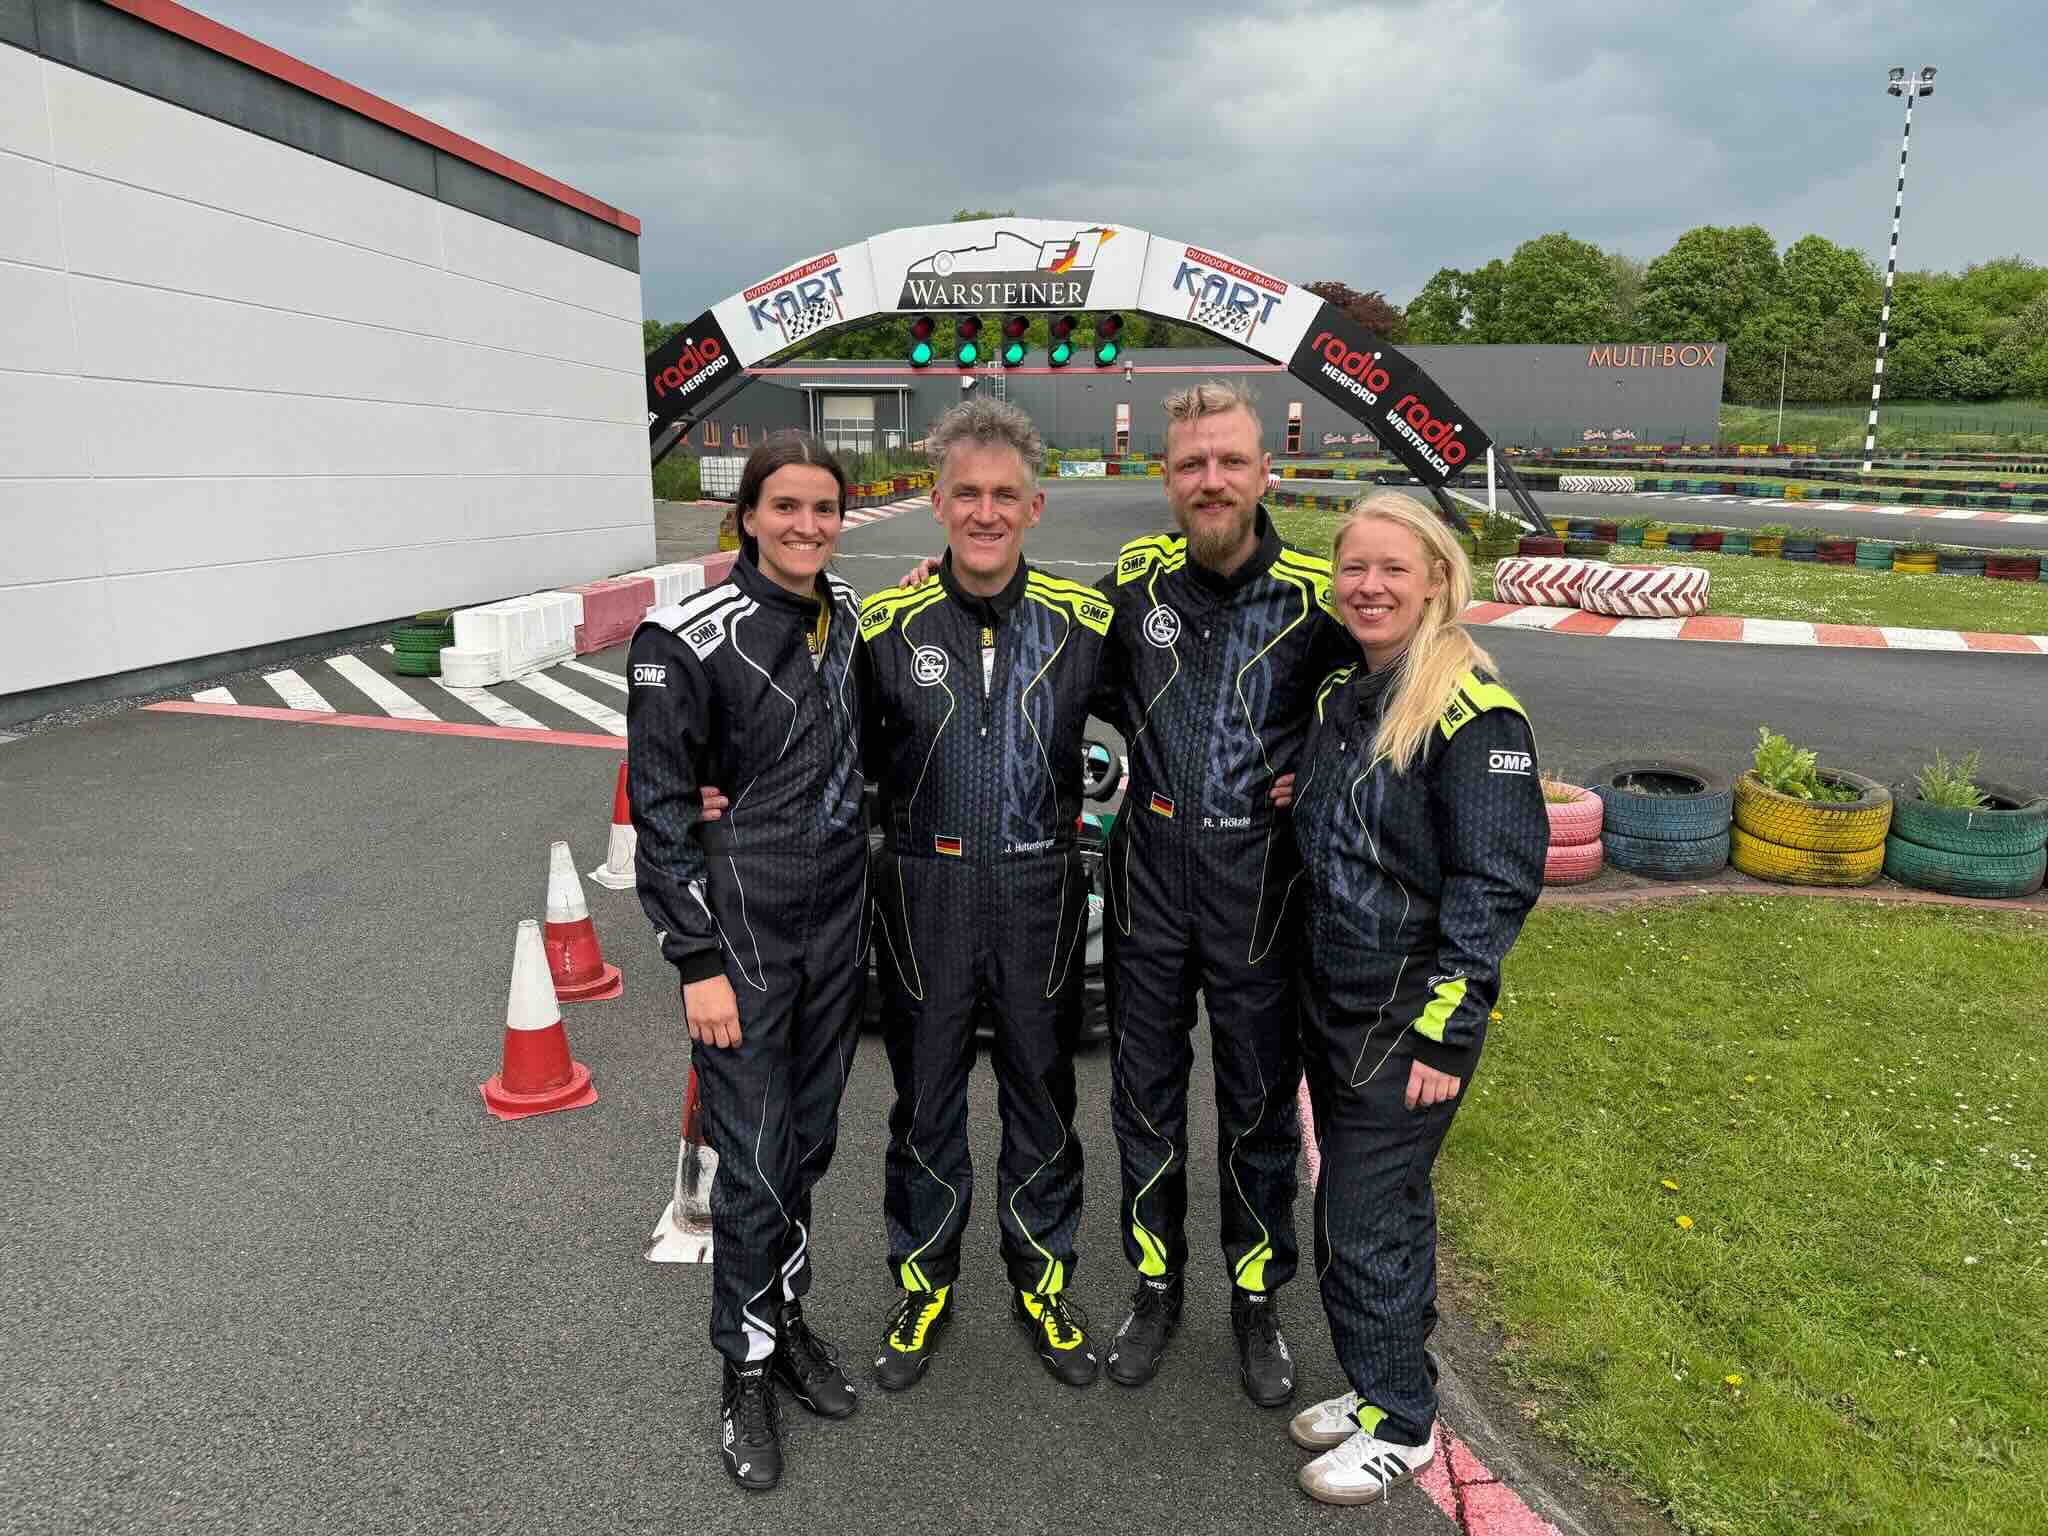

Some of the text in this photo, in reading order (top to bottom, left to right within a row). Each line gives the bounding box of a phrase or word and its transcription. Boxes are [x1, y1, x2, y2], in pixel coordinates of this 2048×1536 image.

[745, 255, 836, 300] OUTDOOR KART RACING
[1186, 249, 1286, 293] OUTDOOR KART RACING
[748, 268, 844, 331] KART
[1173, 262, 1281, 324] KART
[653, 337, 721, 399] radio
[679, 354, 729, 396] HERFORD
[1311, 331, 1390, 393] radio
[1587, 345, 1715, 368] MULTI-BOX
[1320, 362, 1378, 406] HERFORD
[1385, 409, 1451, 477] WESTFALICA
[1391, 393, 1467, 465] radio
[1121, 556, 1146, 572] OMP
[690, 622, 718, 645] OMP
[861, 607, 889, 627] OMP
[1079, 603, 1109, 621] OMP
[633, 667, 666, 682] OMP
[1488, 754, 1532, 771] OMP
[1203, 817, 1214, 828] R.
